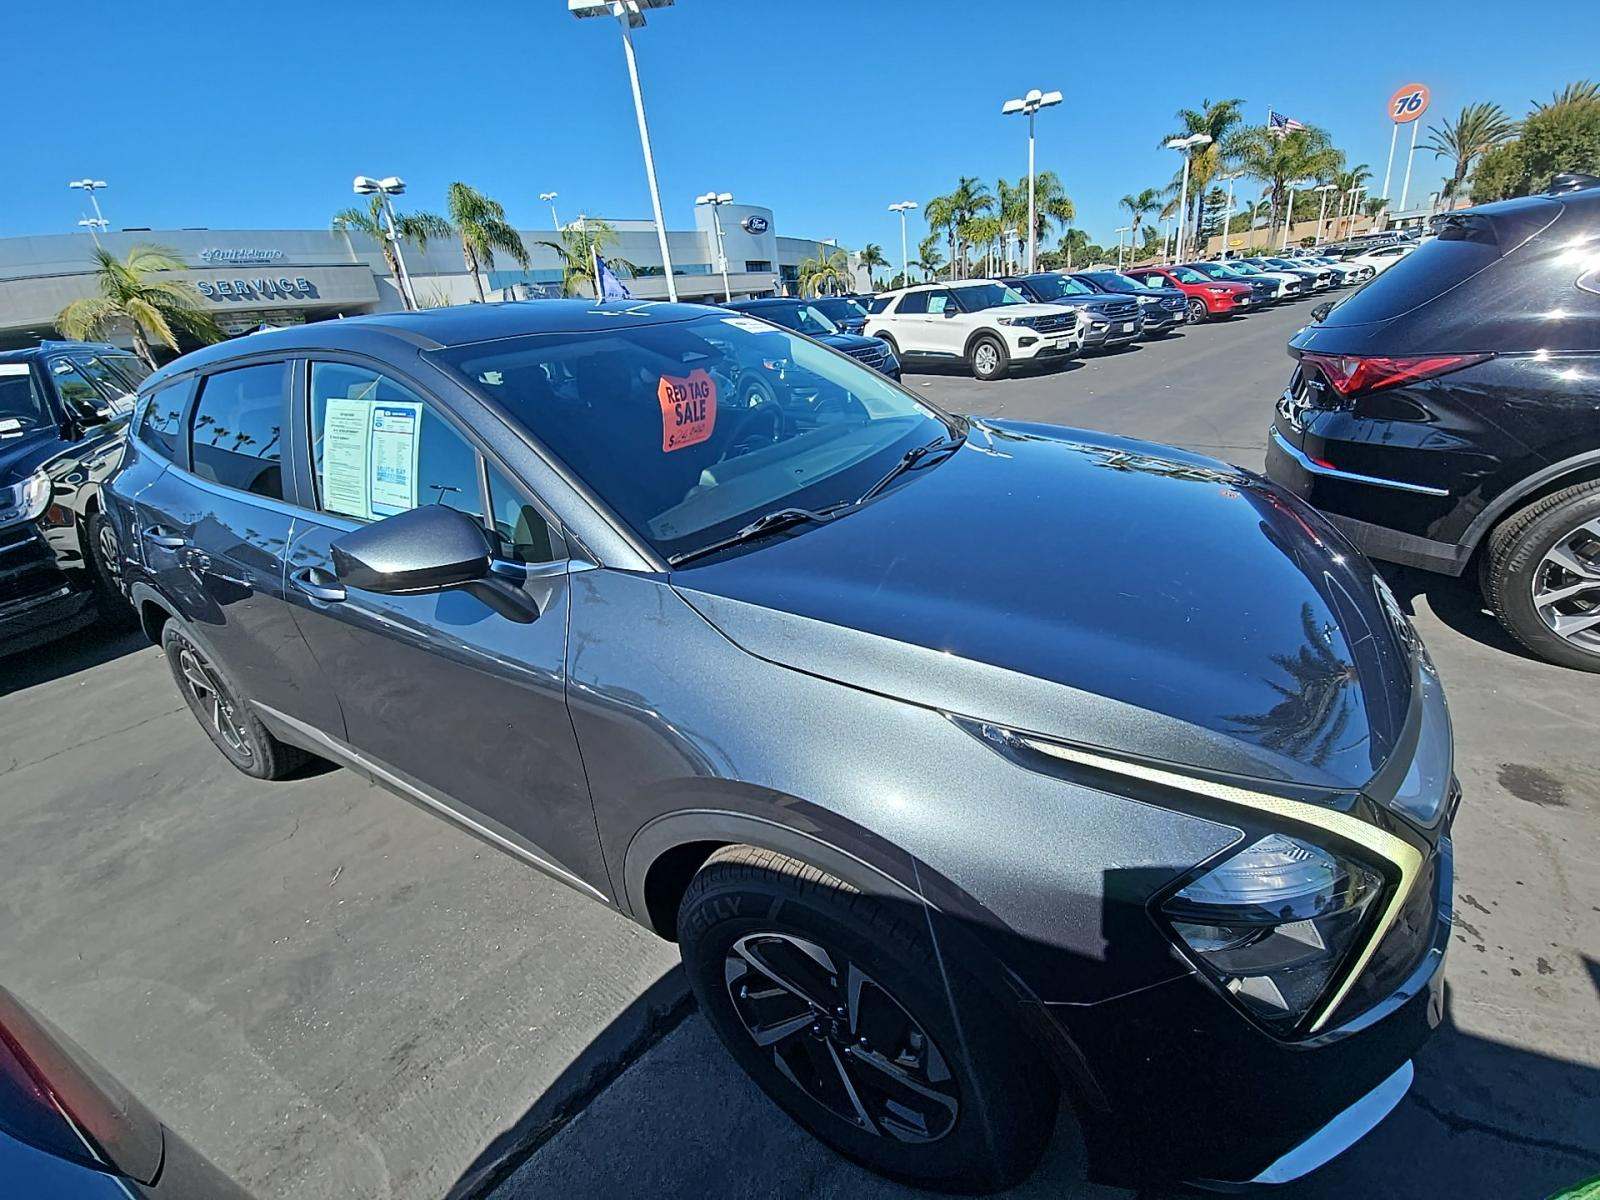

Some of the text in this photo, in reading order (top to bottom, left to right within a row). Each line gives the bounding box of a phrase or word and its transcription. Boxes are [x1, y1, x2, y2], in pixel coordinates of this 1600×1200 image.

[1395, 91, 1423, 115] 76
[197, 277, 310, 296] SERVICE
[665, 381, 710, 404] RED TAG
[675, 400, 706, 426] SALE
